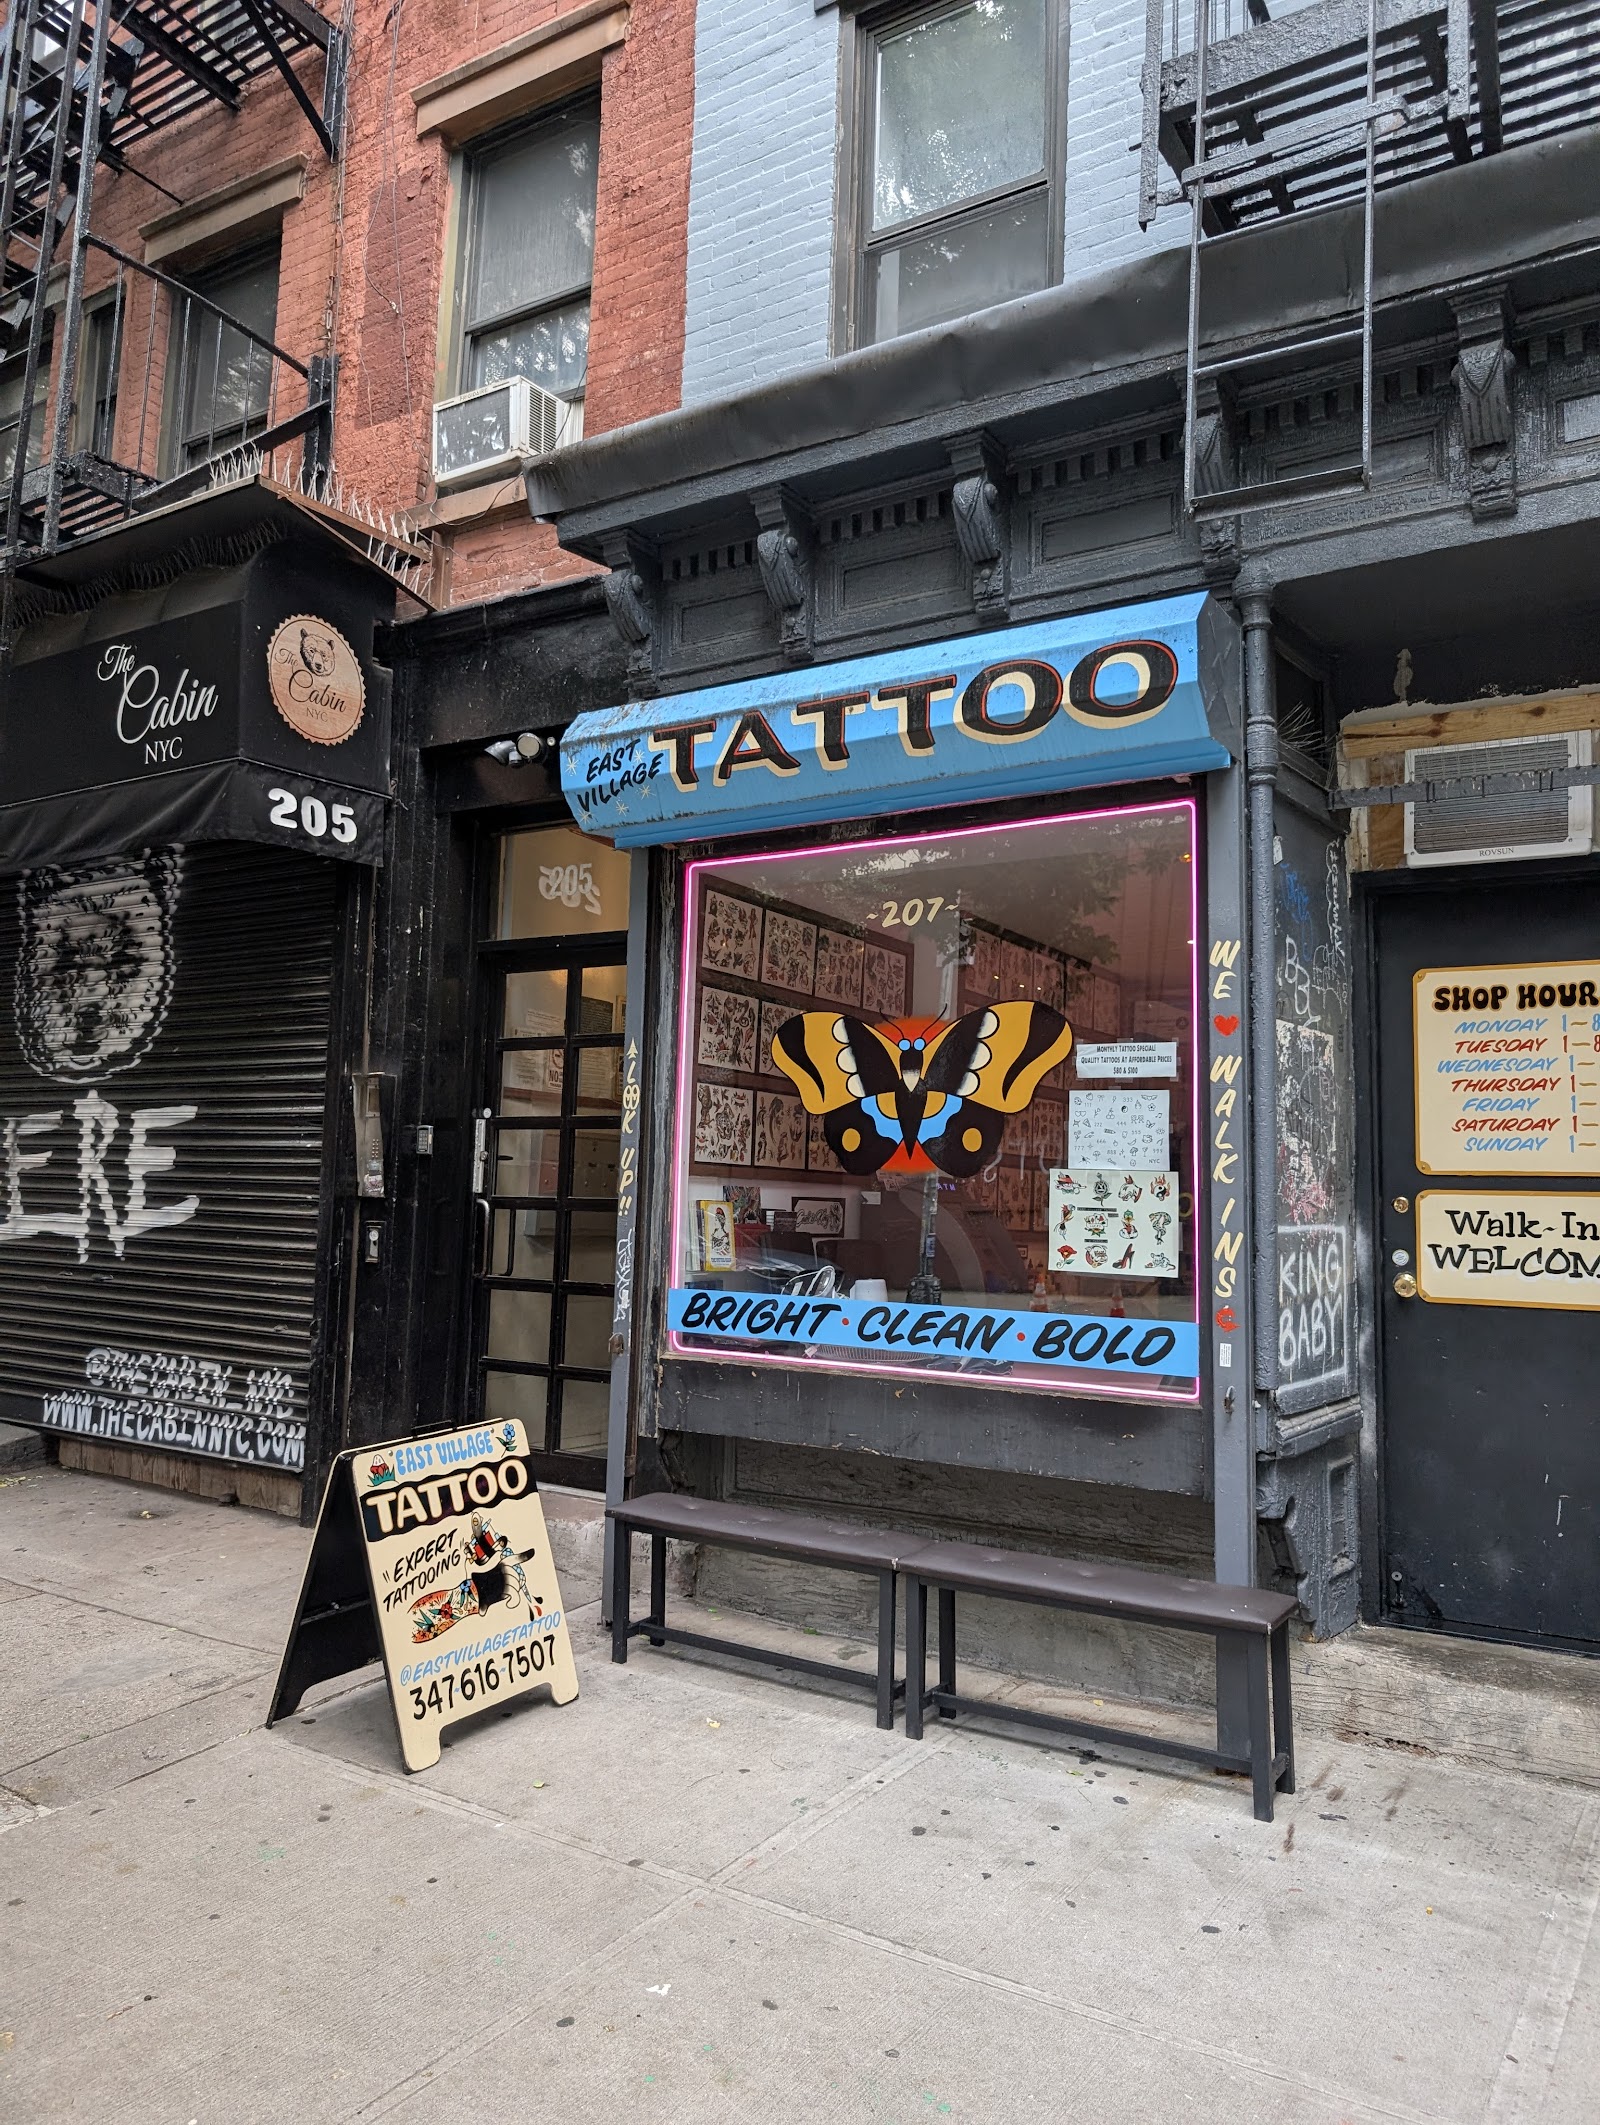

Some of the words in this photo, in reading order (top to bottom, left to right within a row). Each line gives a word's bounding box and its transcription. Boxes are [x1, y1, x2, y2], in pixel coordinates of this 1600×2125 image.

[97, 644, 136, 682] The
[117, 664, 219, 744] Cabin
[274, 647, 299, 667] The
[288, 668, 347, 713] Cabin
[306, 706, 328, 723] NYC
[649, 640, 1178, 792] TATTOO
[144, 737, 183, 765] NYC
[586, 738, 641, 784] EAST
[577, 752, 664, 812] VILLAGE
[267, 787, 358, 844] 205
[1479, 847, 1515, 857] ROVSUN
[550, 862, 593, 897] 205
[1209, 940, 1241, 1000] WE
[1432, 985, 1509, 1012] SHOP
[1516, 981, 1600, 1010] HOUR
[1454, 1018, 1548, 1034] MONDAY
[1454, 1037, 1548, 1054] TUESDAY
[1081, 1056, 1100, 1064] QUALITY
[1129, 1055, 1157, 1063] AFFORDABLE
[1157, 1055, 1172, 1063] PRICES
[1119, 1045, 1136, 1053] TATTOO
[1437, 1057, 1558, 1074] WEDNESDAY
[1451, 1077, 1561, 1093] THURSDAY
[1462, 1097, 1540, 1112] FRIDAY
[1209, 1055, 1242, 1184] WALK
[1452, 1117, 1560, 1133] SATURDAY
[1464, 1137, 1548, 1152] SUNDAY
[0, 1089, 200, 1264] ERE
[1213, 1198, 1244, 1298] INS
[1279, 1243, 1342, 1302] KING
[681, 1292, 842, 1337] BRIGHT
[857, 1306, 1016, 1354] CLEAN
[1032, 1319, 1176, 1367] BOLD
[1279, 1295, 1342, 1367] BABY
[396, 1442, 434, 1475] EAST
[435, 1430, 494, 1466] VILLAGE
[366, 1458, 528, 1533] TATTOO
[400, 1611, 561, 1687] @EASTVILLAGETATTOO
